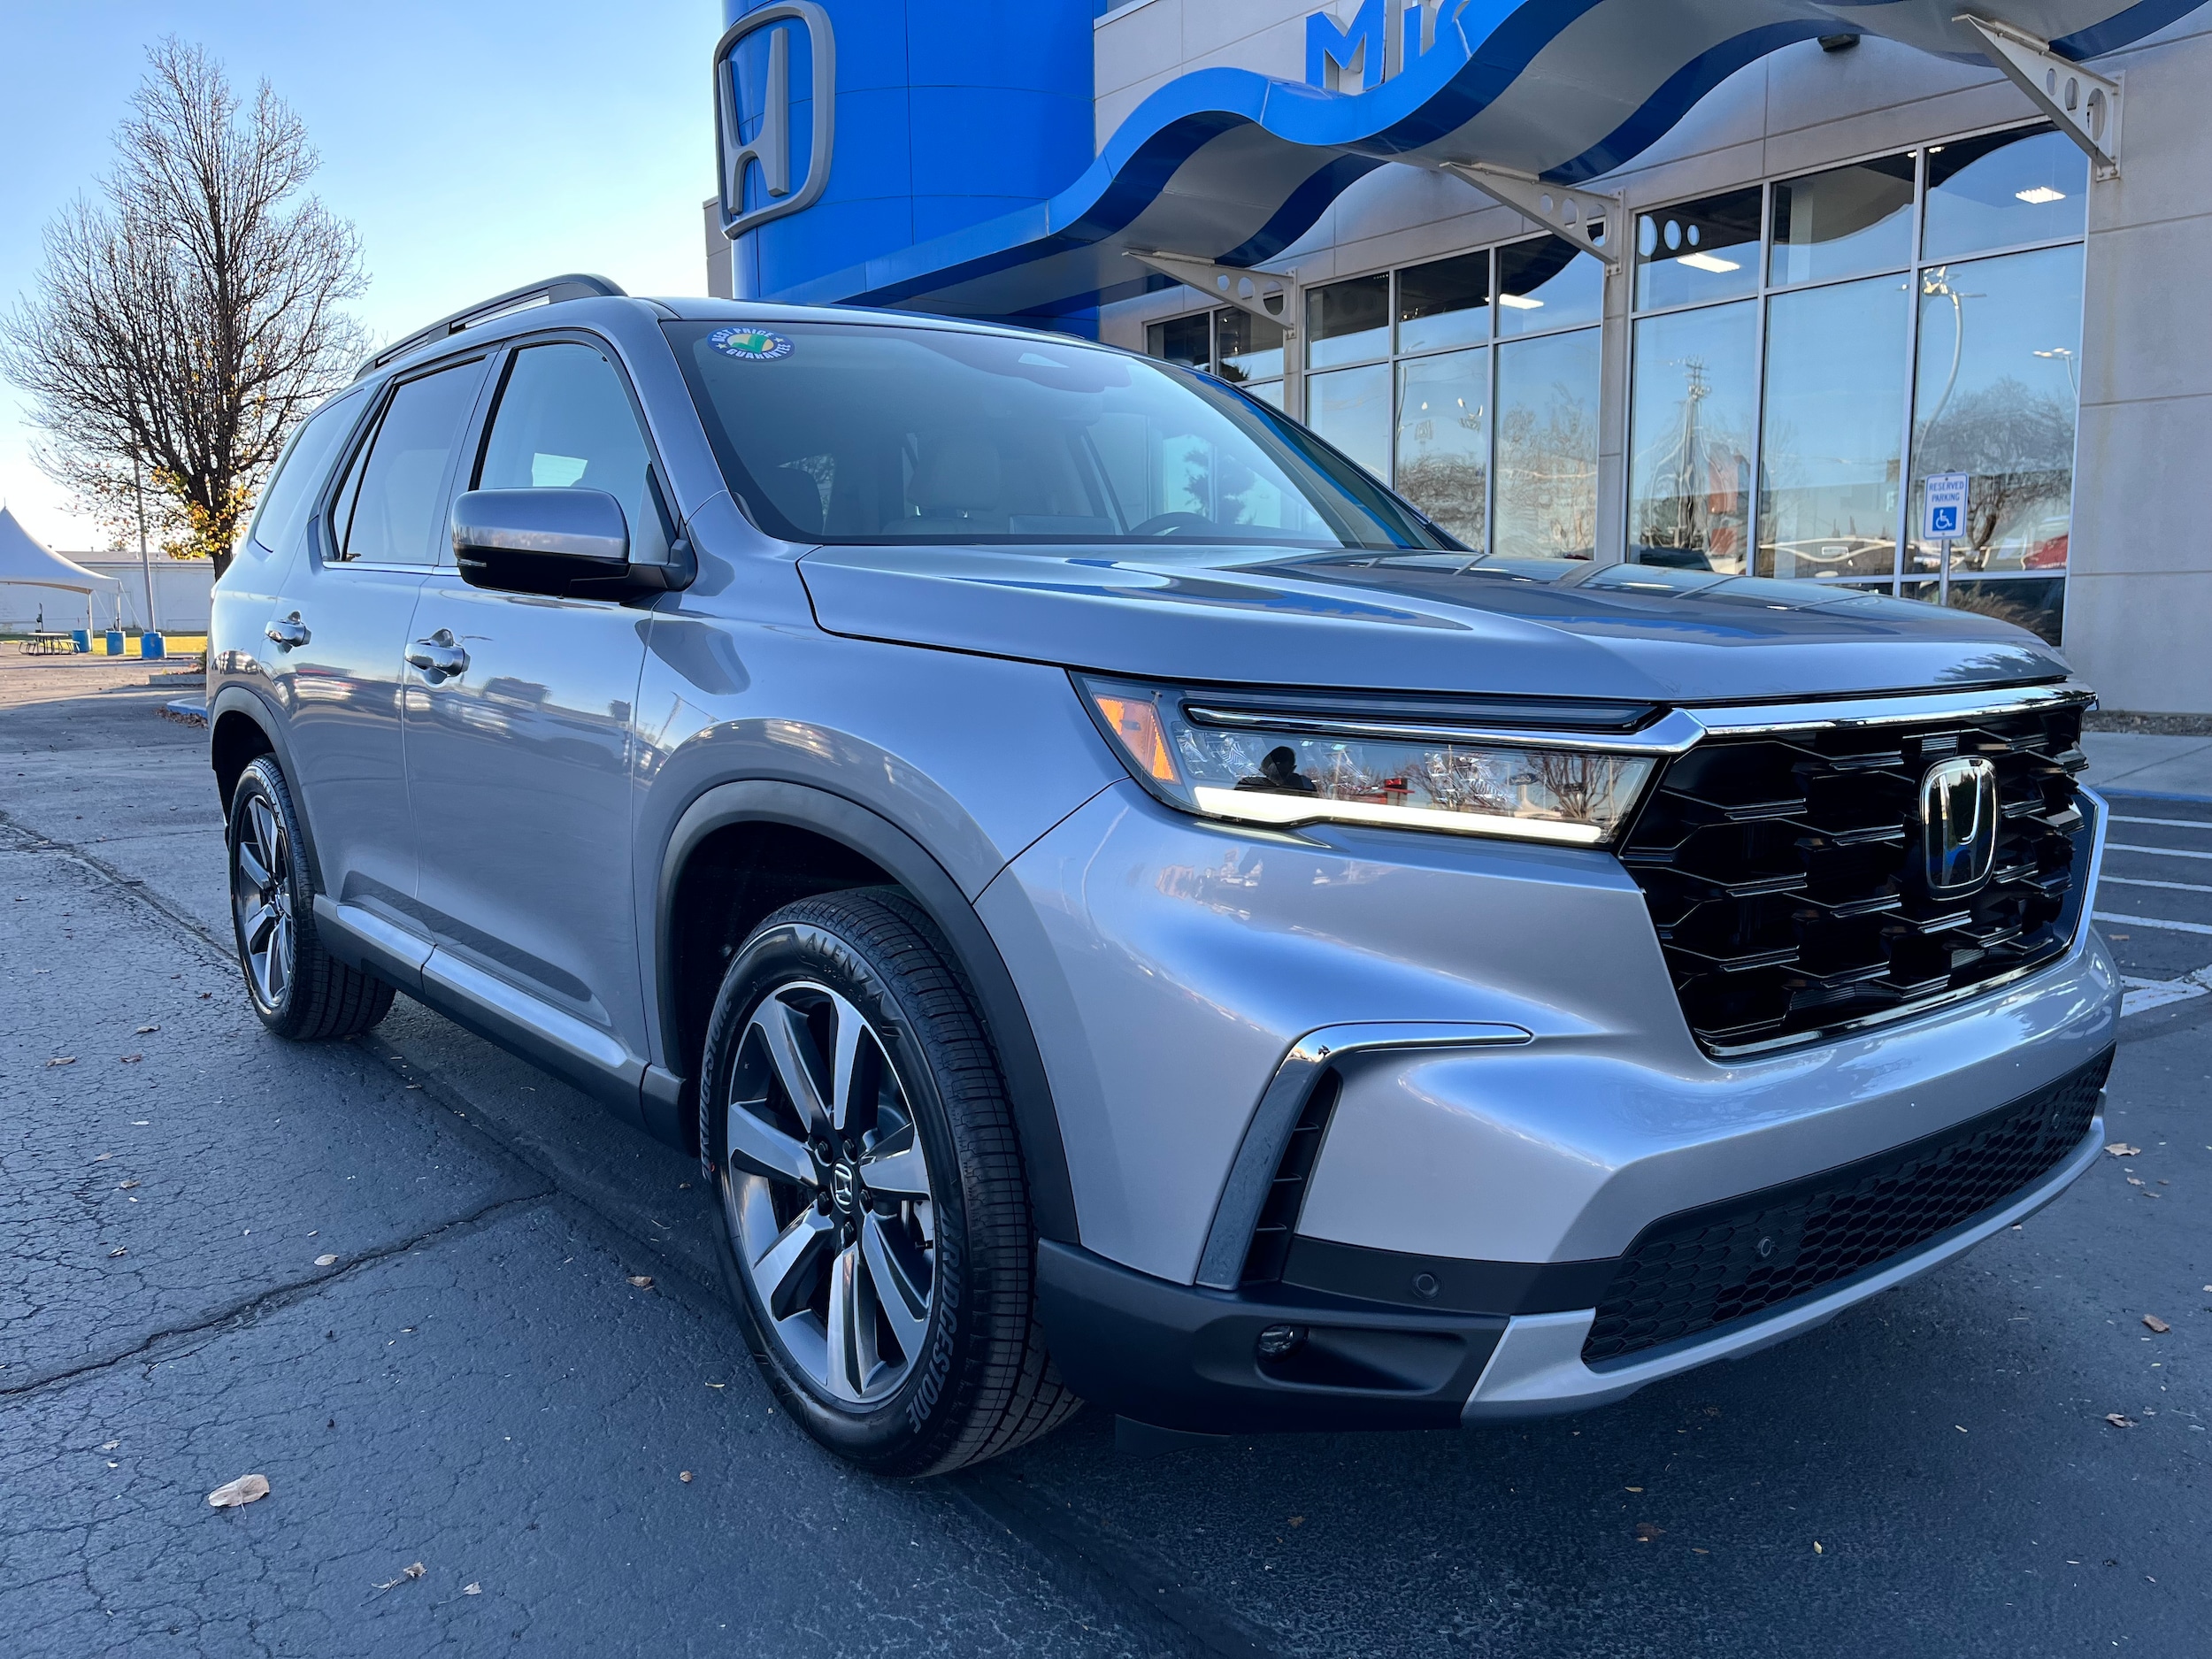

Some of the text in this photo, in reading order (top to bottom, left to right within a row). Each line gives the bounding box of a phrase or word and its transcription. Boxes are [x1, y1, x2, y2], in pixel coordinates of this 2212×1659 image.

[711, 327, 775, 342] BEST PRICE
[726, 342, 792, 360] GUARANTEE
[1929, 480, 1964, 492] RESERVED
[1932, 492, 1960, 503] PARKING
[803, 932, 886, 1011] ALENZA
[905, 1202, 963, 1434] BRIDGESTONE
